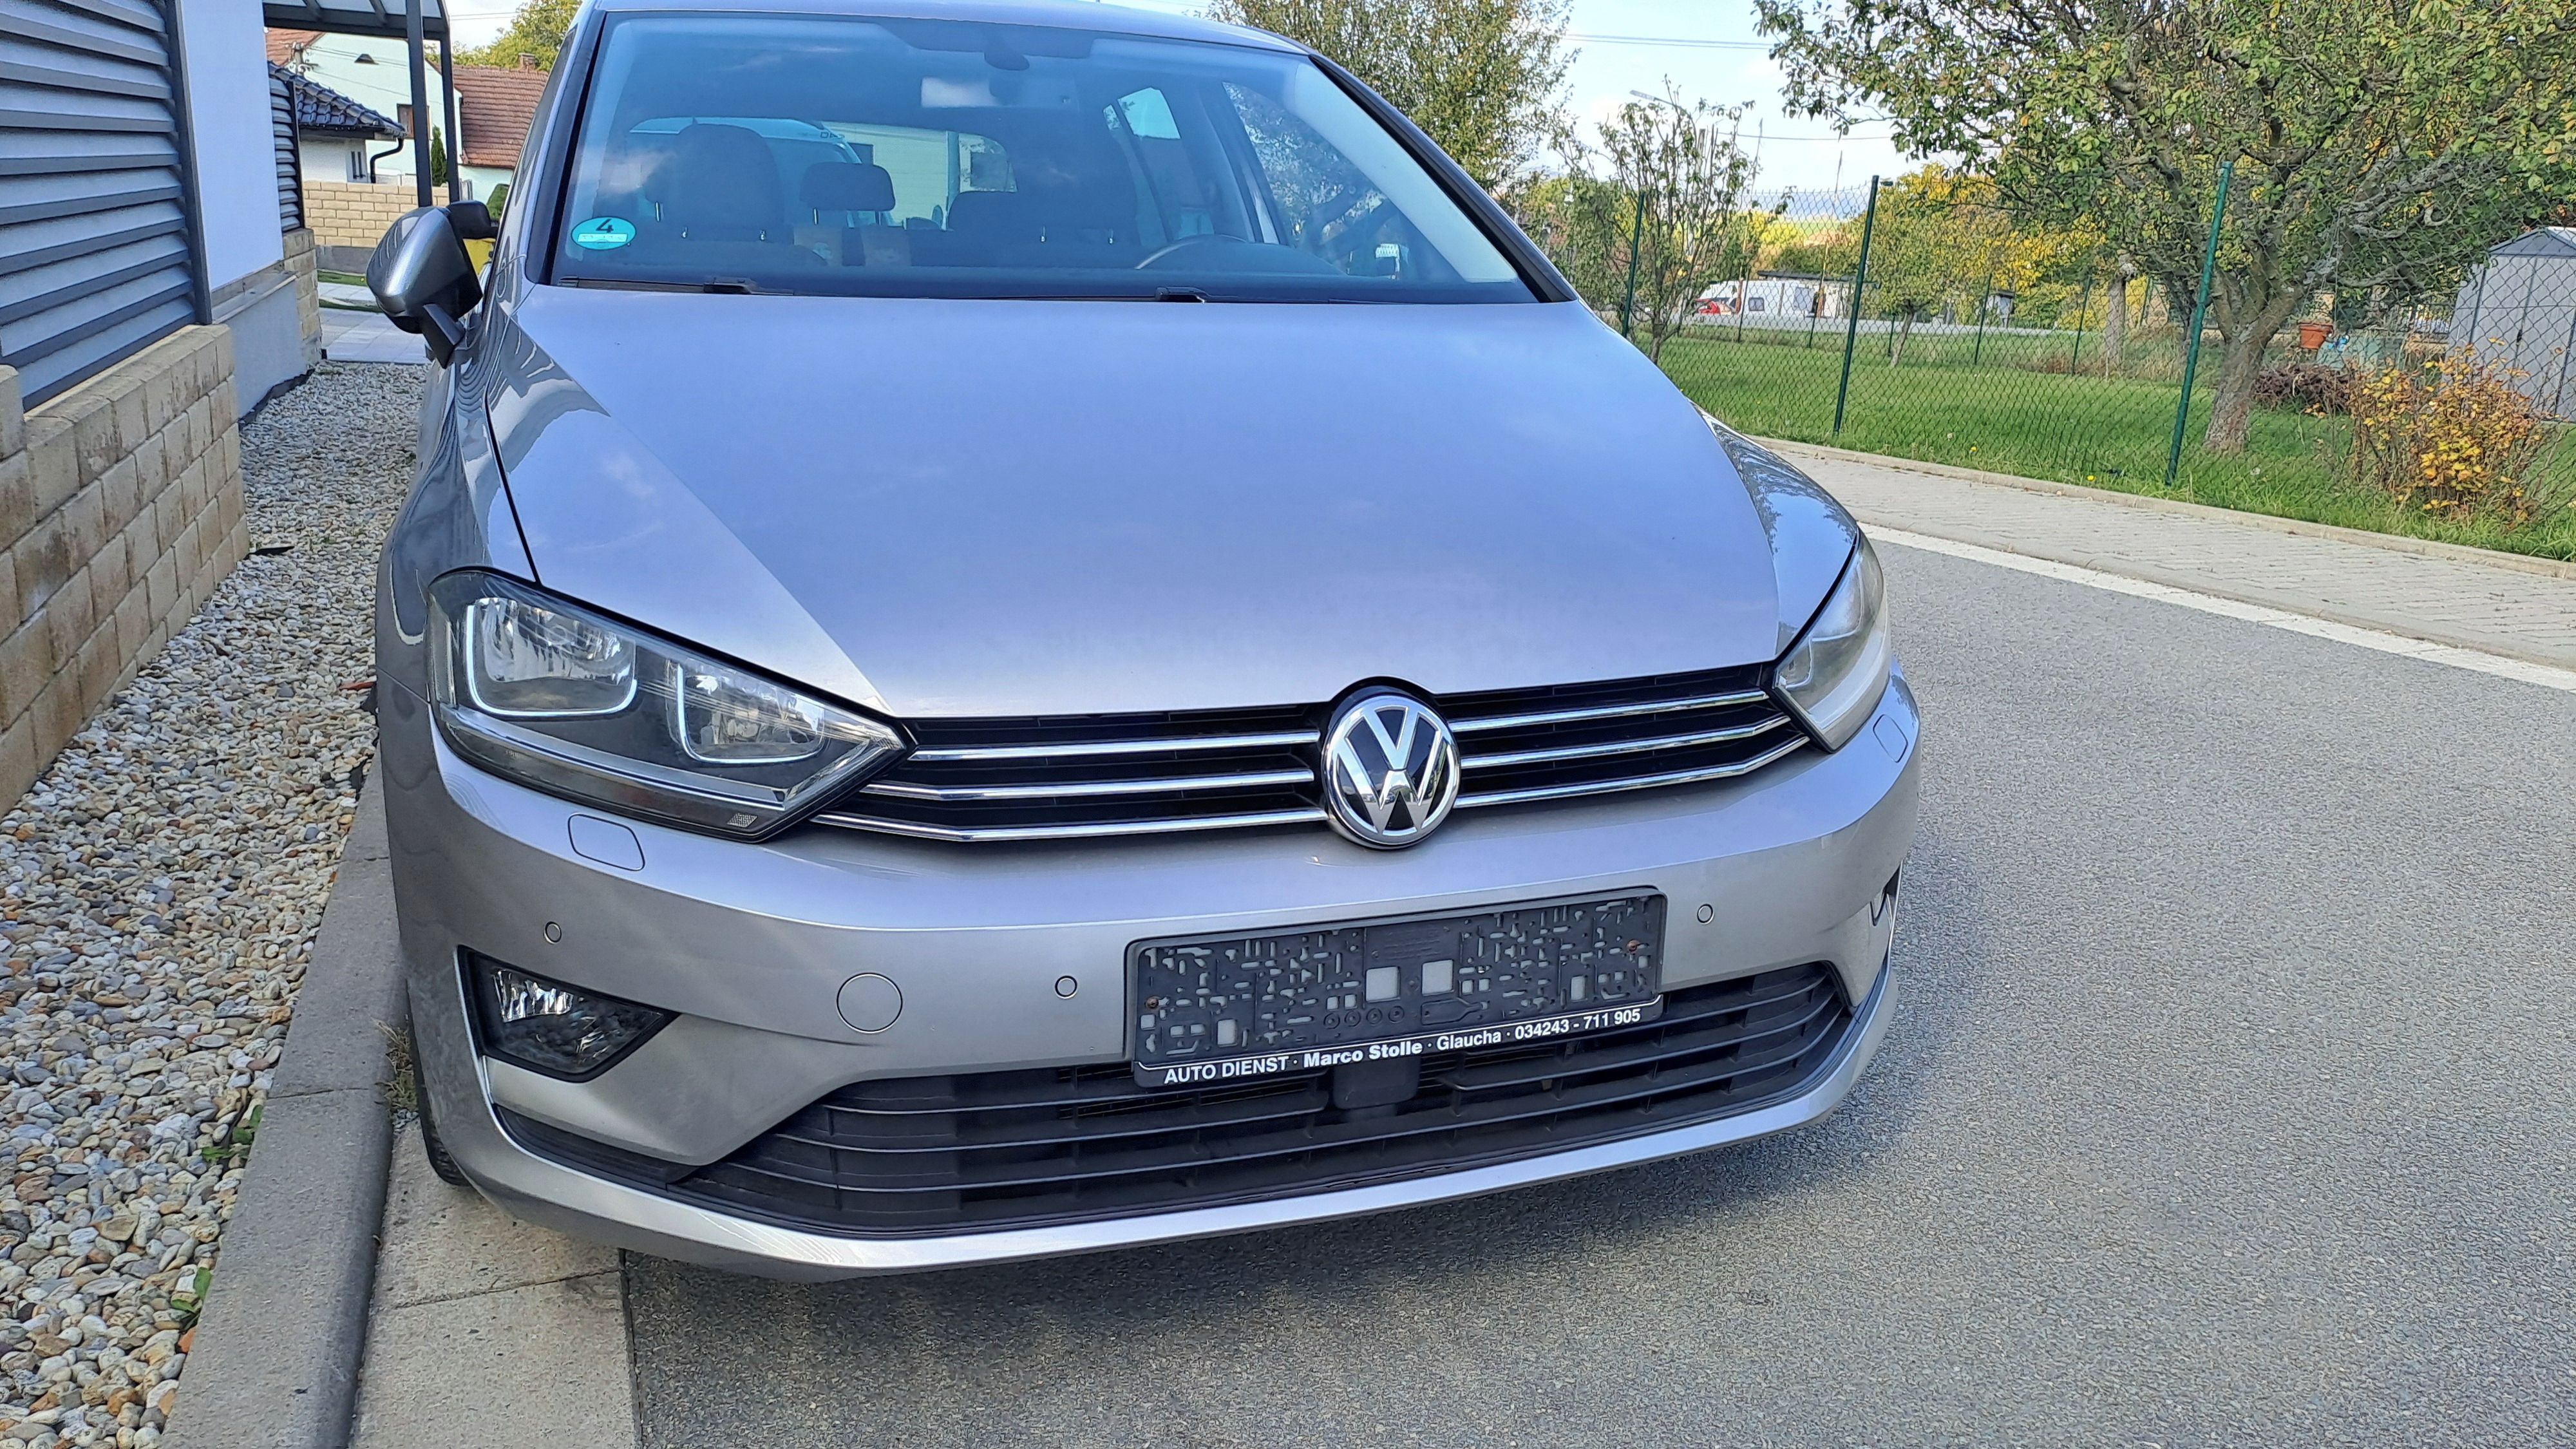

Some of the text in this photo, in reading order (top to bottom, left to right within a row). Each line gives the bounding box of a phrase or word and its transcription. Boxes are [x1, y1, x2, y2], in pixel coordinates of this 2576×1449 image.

[596, 218, 614, 233] 4
[1331, 701, 1453, 837] VW
[1164, 1064, 1217, 1084] AUTO
[1222, 1056, 1289, 1078] DIENST
[1303, 1049, 1363, 1068] Marco
[1368, 1041, 1423, 1060] Stolle
[1437, 1030, 1502, 1050] Glaucha
[1515, 1019, 1569, 1039] 034243
[1583, 1012, 1609, 1029] 711
[1614, 1008, 1641, 1025] 905
